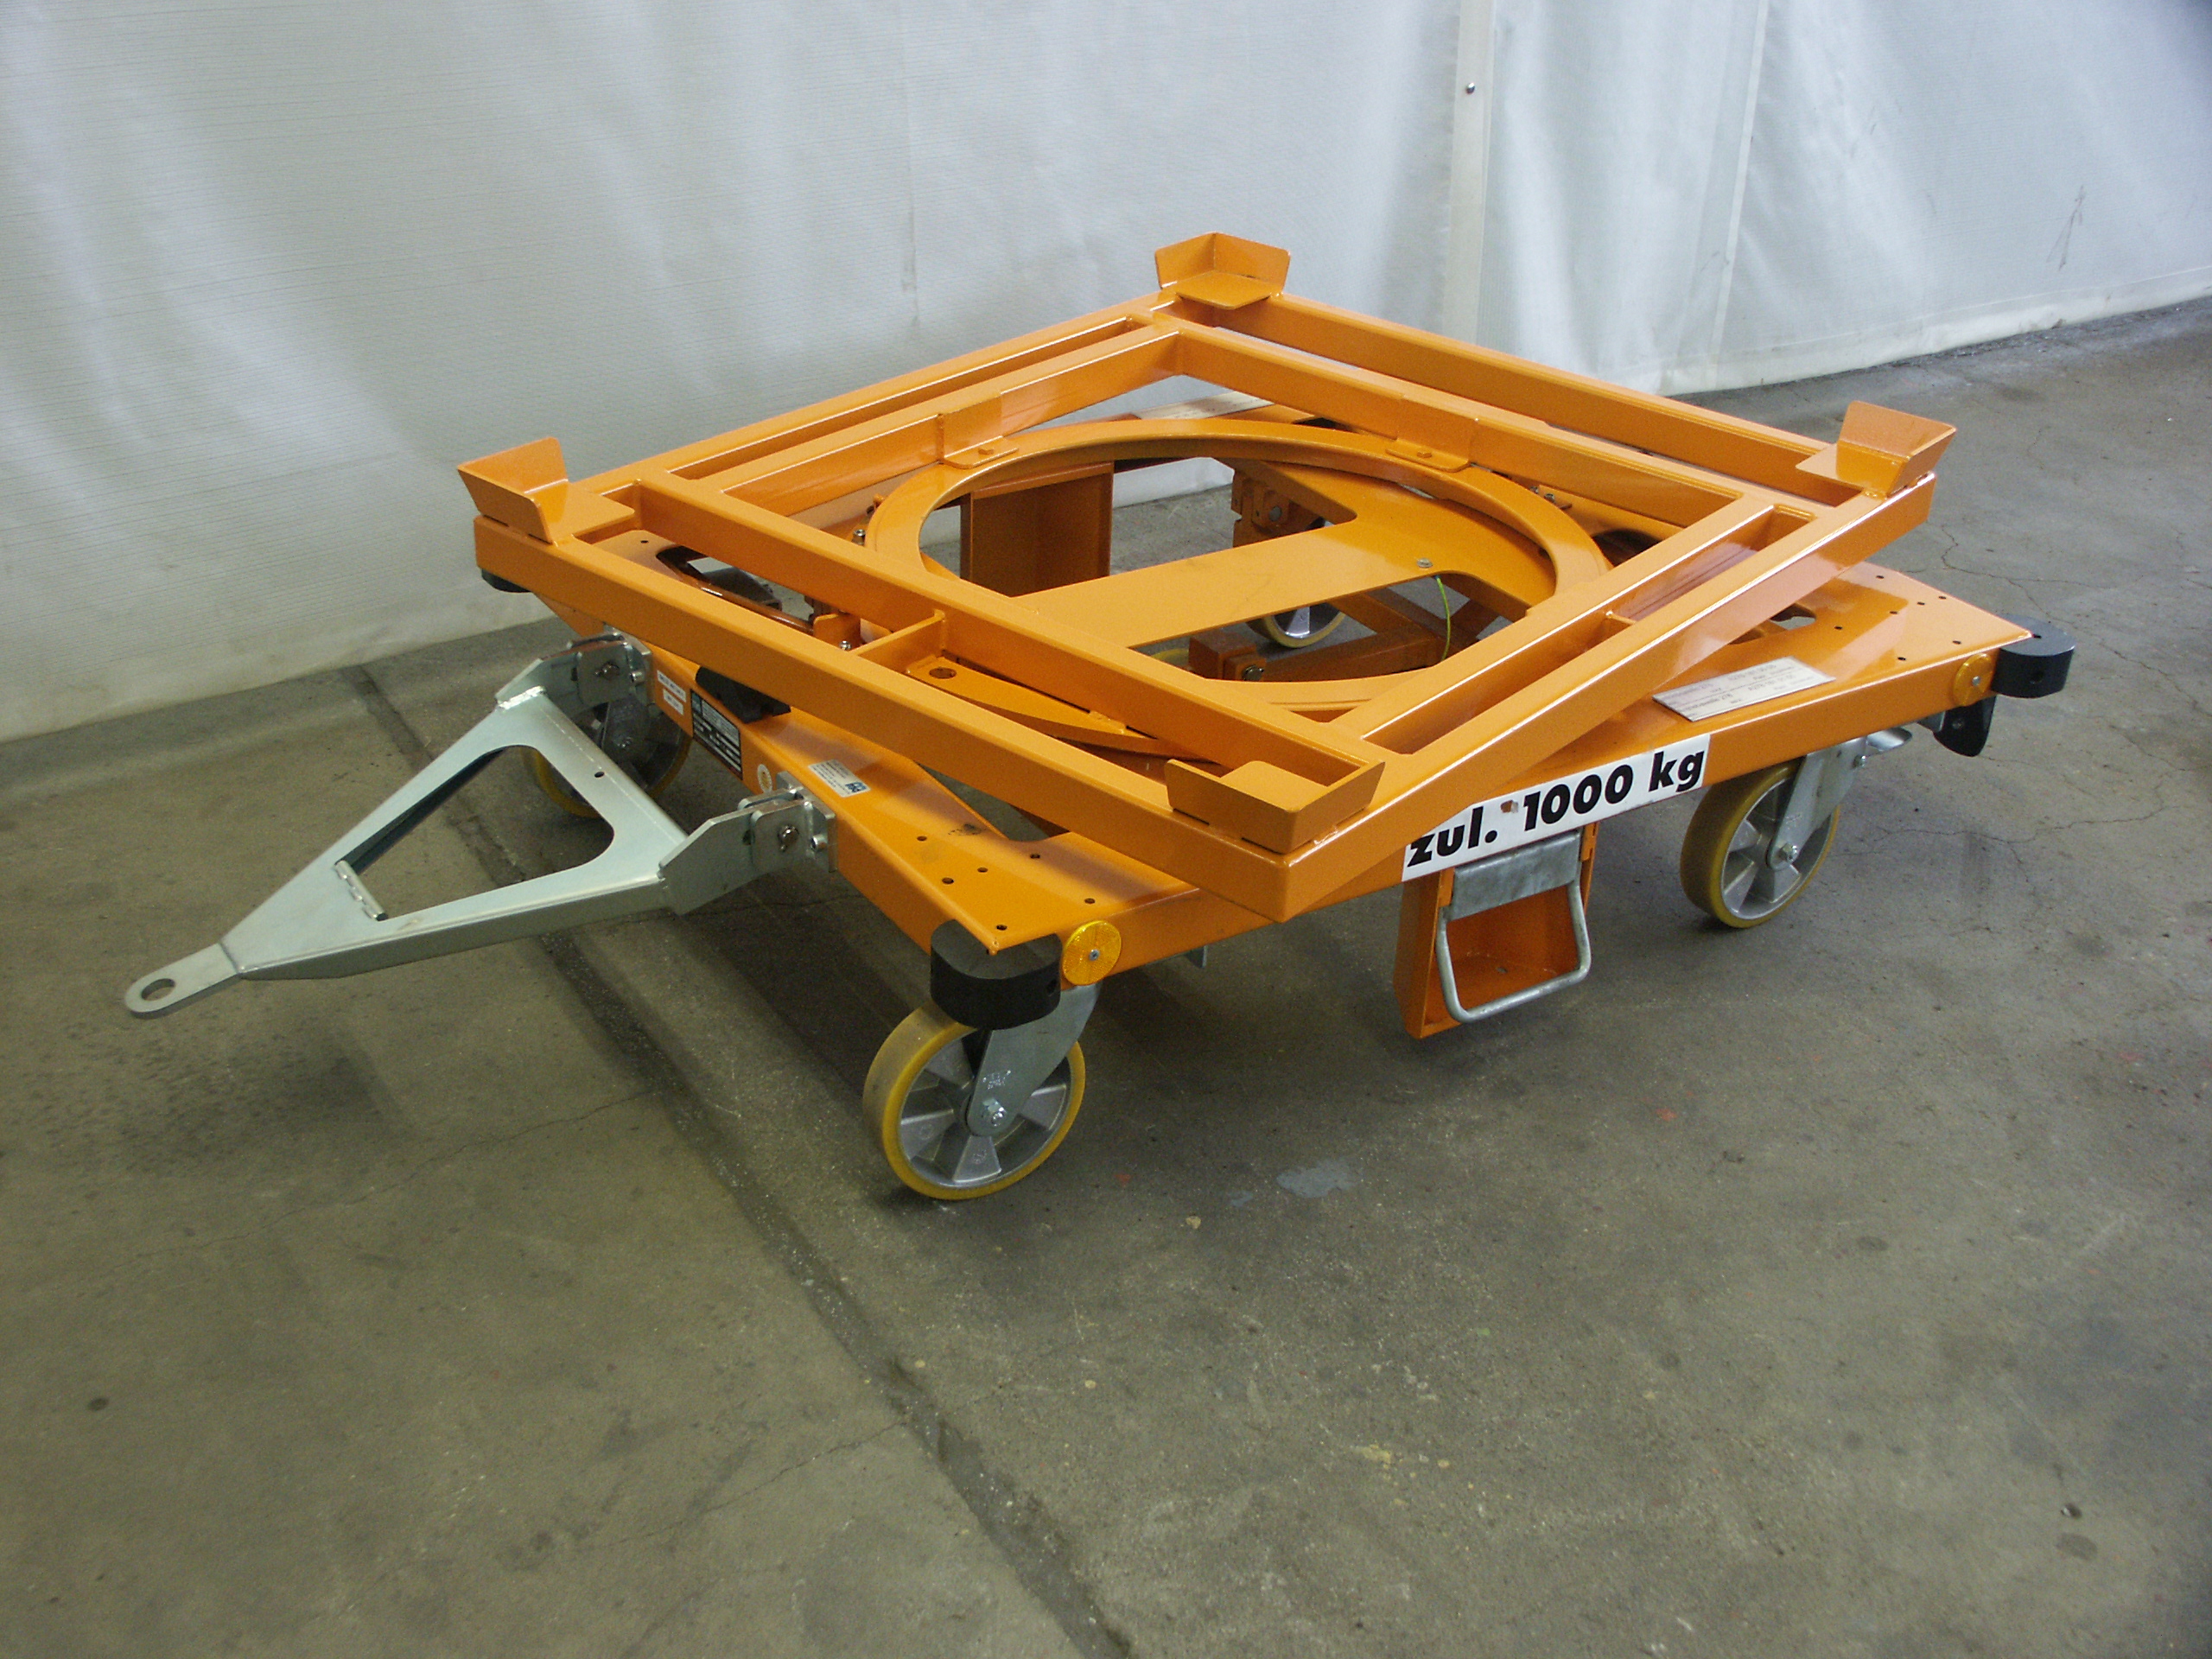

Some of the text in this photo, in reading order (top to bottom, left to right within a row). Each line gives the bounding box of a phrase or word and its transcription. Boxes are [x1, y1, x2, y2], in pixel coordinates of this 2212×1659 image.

[1407, 750, 1705, 868] zul. 1000 kg
